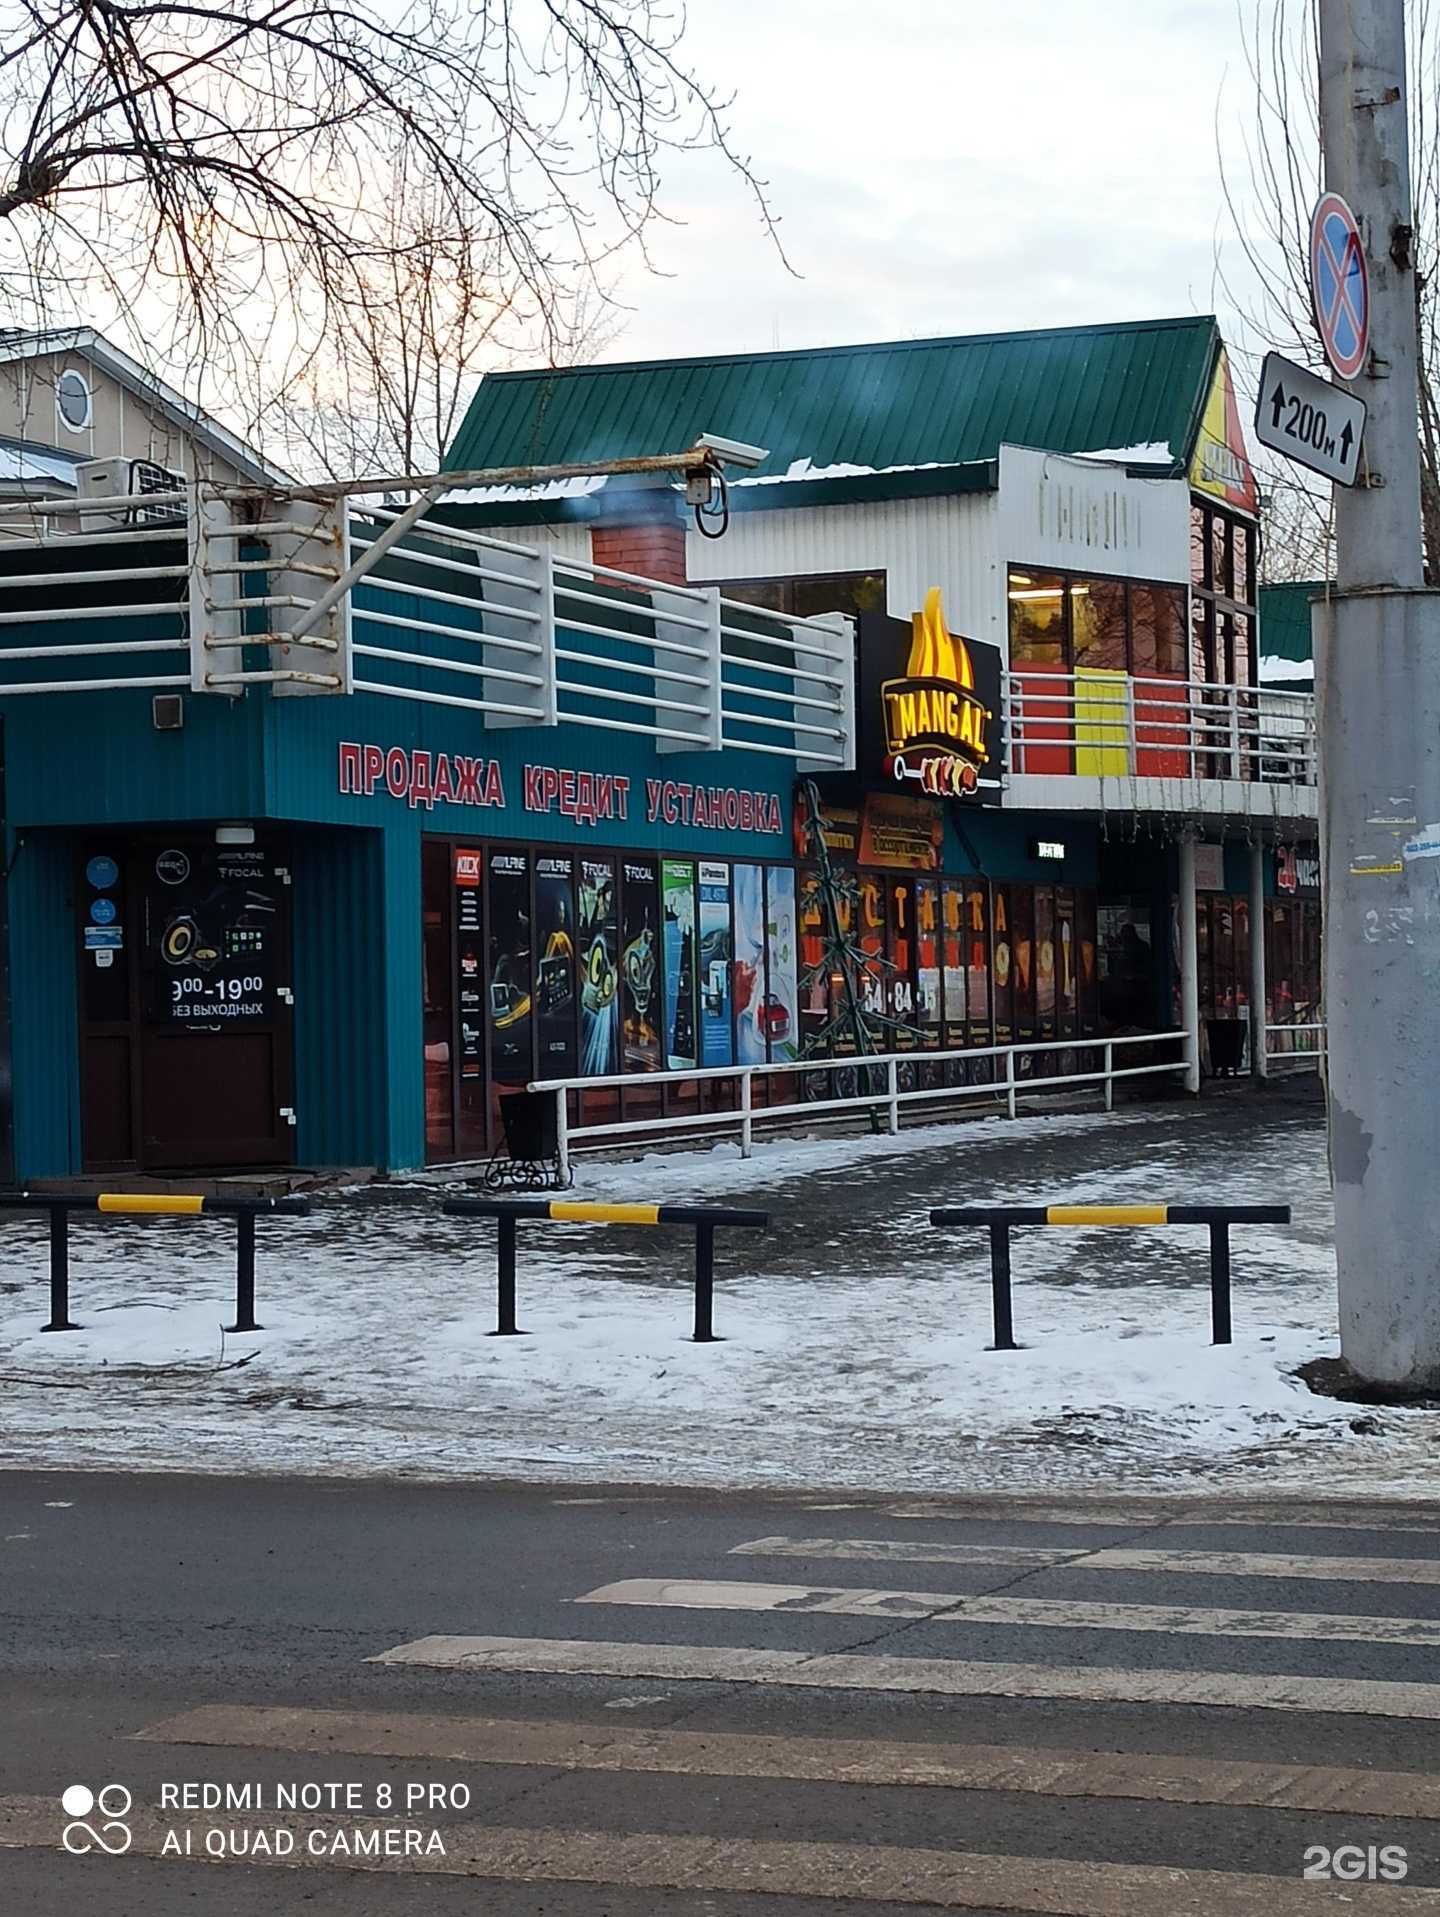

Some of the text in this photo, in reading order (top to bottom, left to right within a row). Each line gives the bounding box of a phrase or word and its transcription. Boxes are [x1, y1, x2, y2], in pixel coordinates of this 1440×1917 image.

[893, 690, 985, 753] MANGAL
[339, 741, 783, 834] ПРОДАЖА КРЕДИТ УСТАНОВКА
[192, 1002, 264, 1017] ВЫХОДНЫХ
